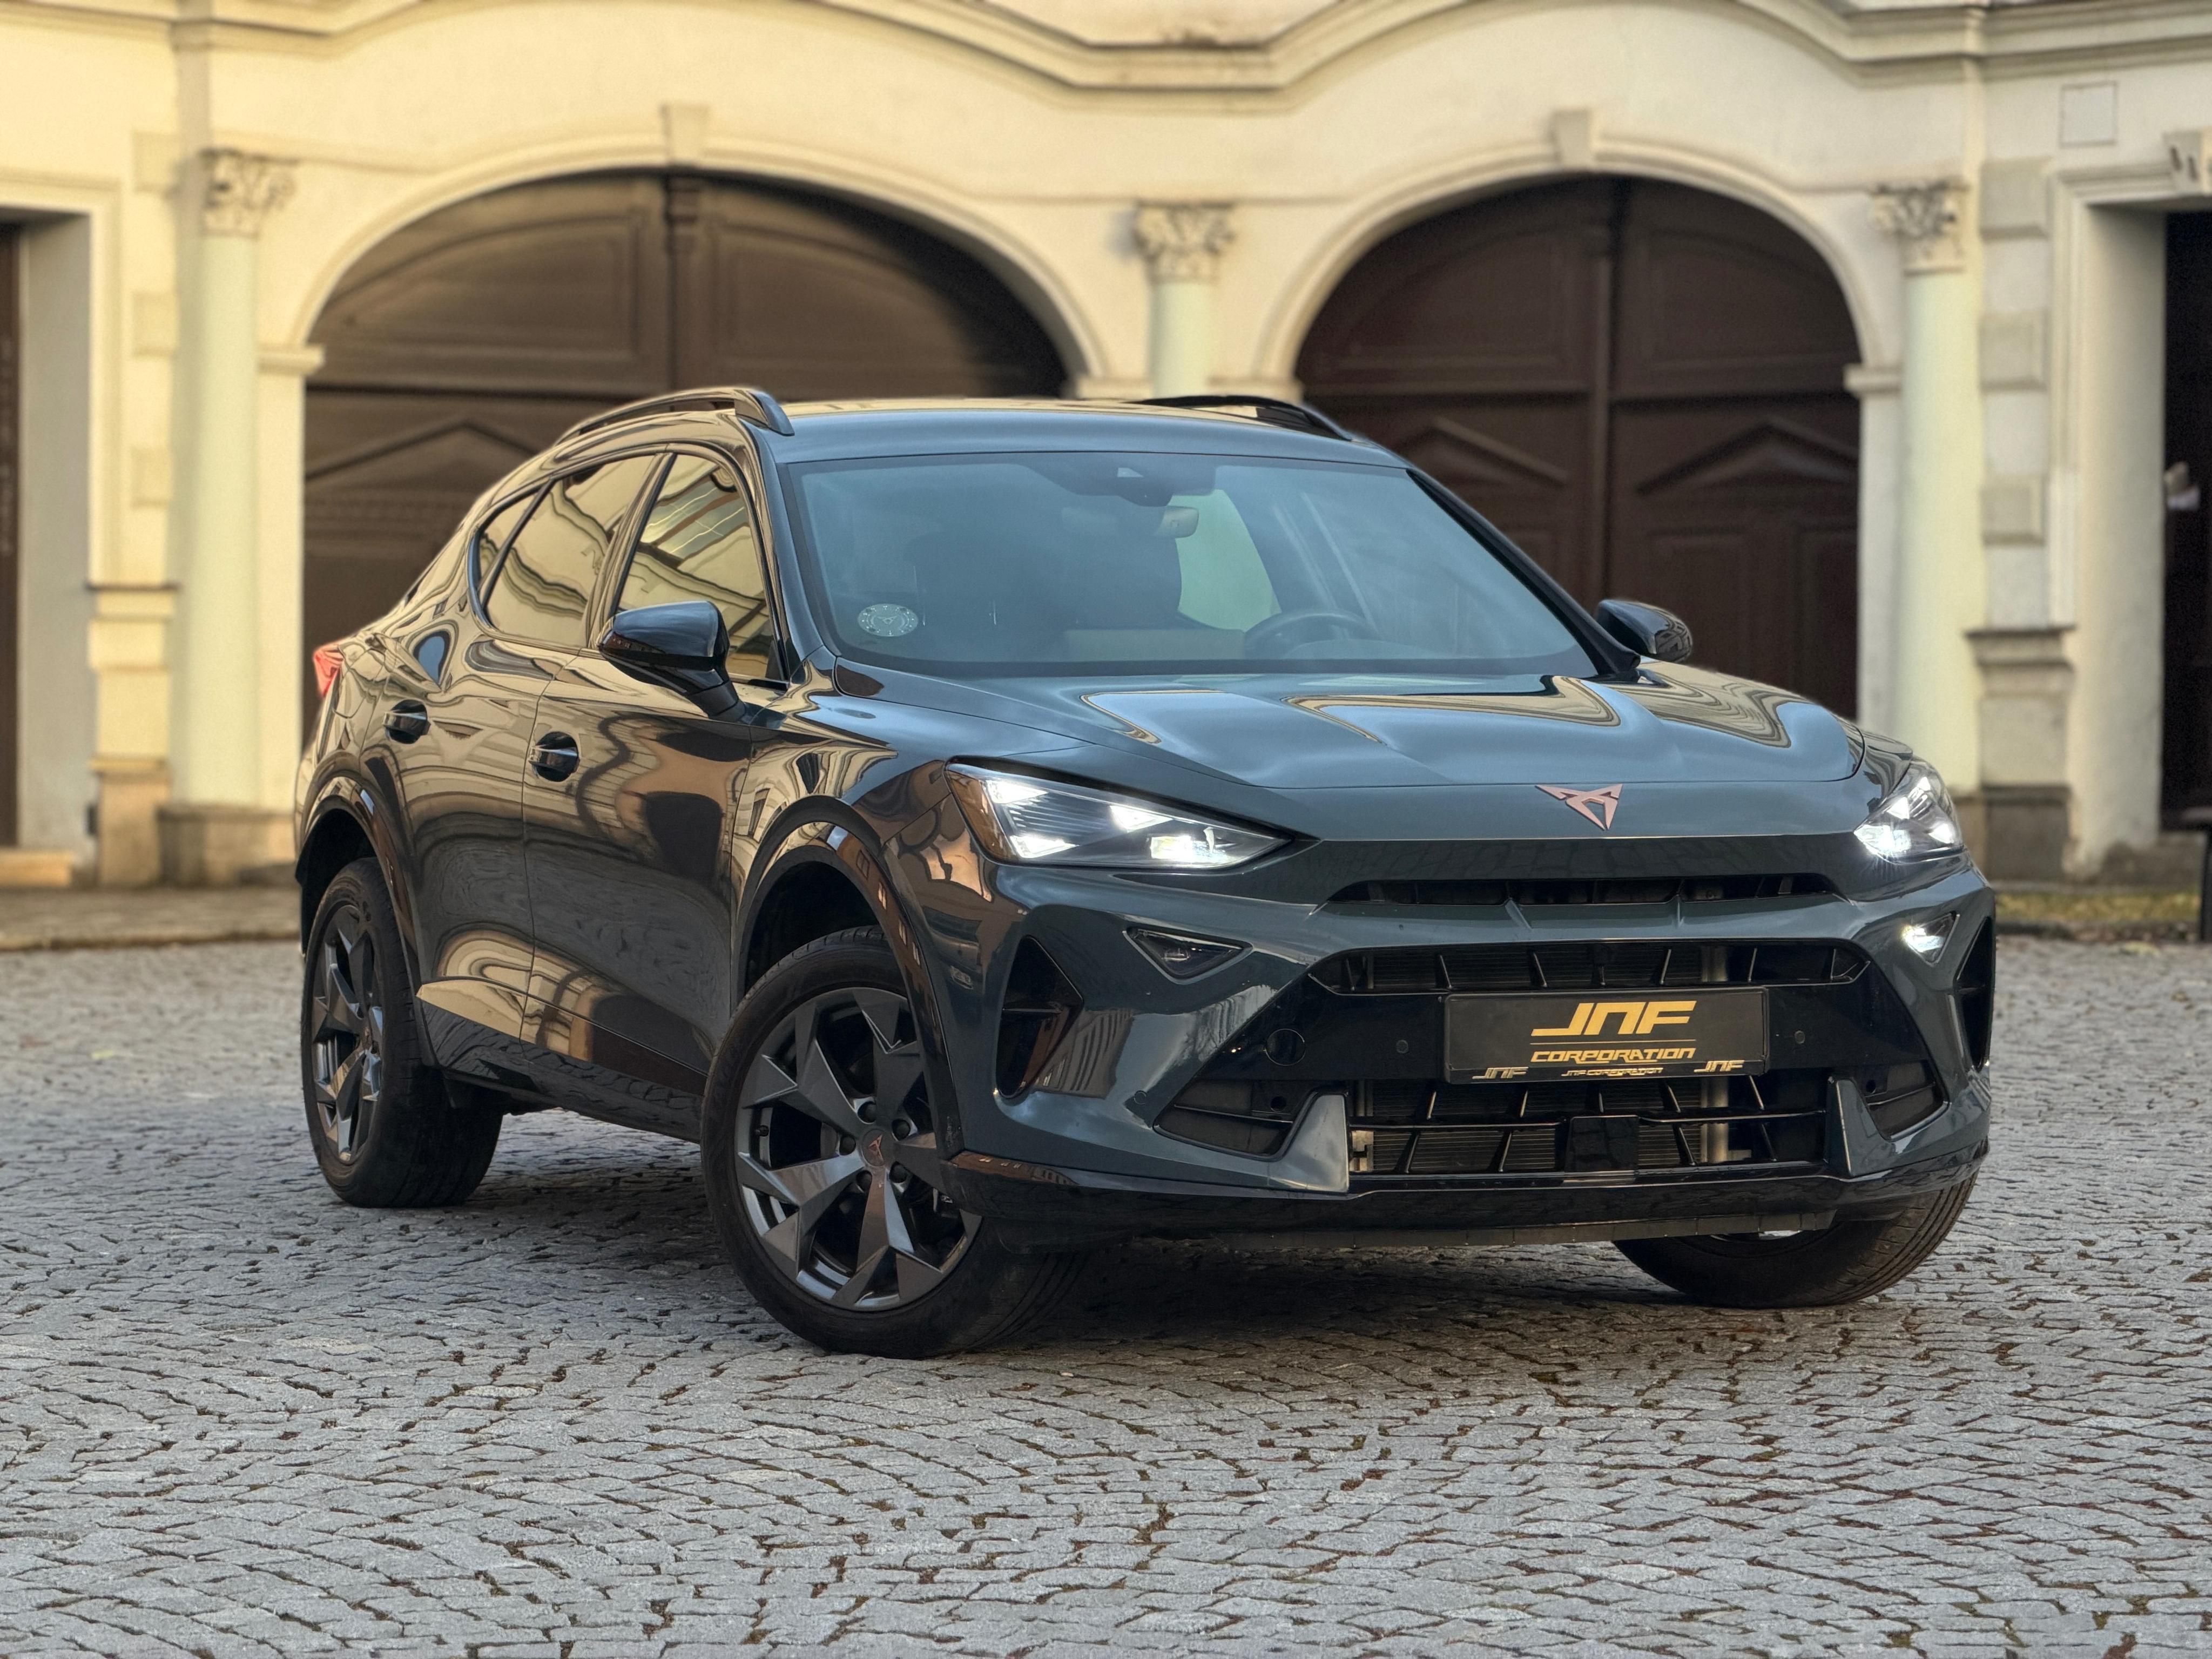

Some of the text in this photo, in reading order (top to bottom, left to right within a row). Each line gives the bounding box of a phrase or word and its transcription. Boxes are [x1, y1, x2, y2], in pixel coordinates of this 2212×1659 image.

[1530, 1001, 1697, 1036] JNF
[1530, 1048, 1696, 1064] CORPORATION
[1472, 1067, 1529, 1079] JNF
[1694, 1060, 1745, 1073] JNF
